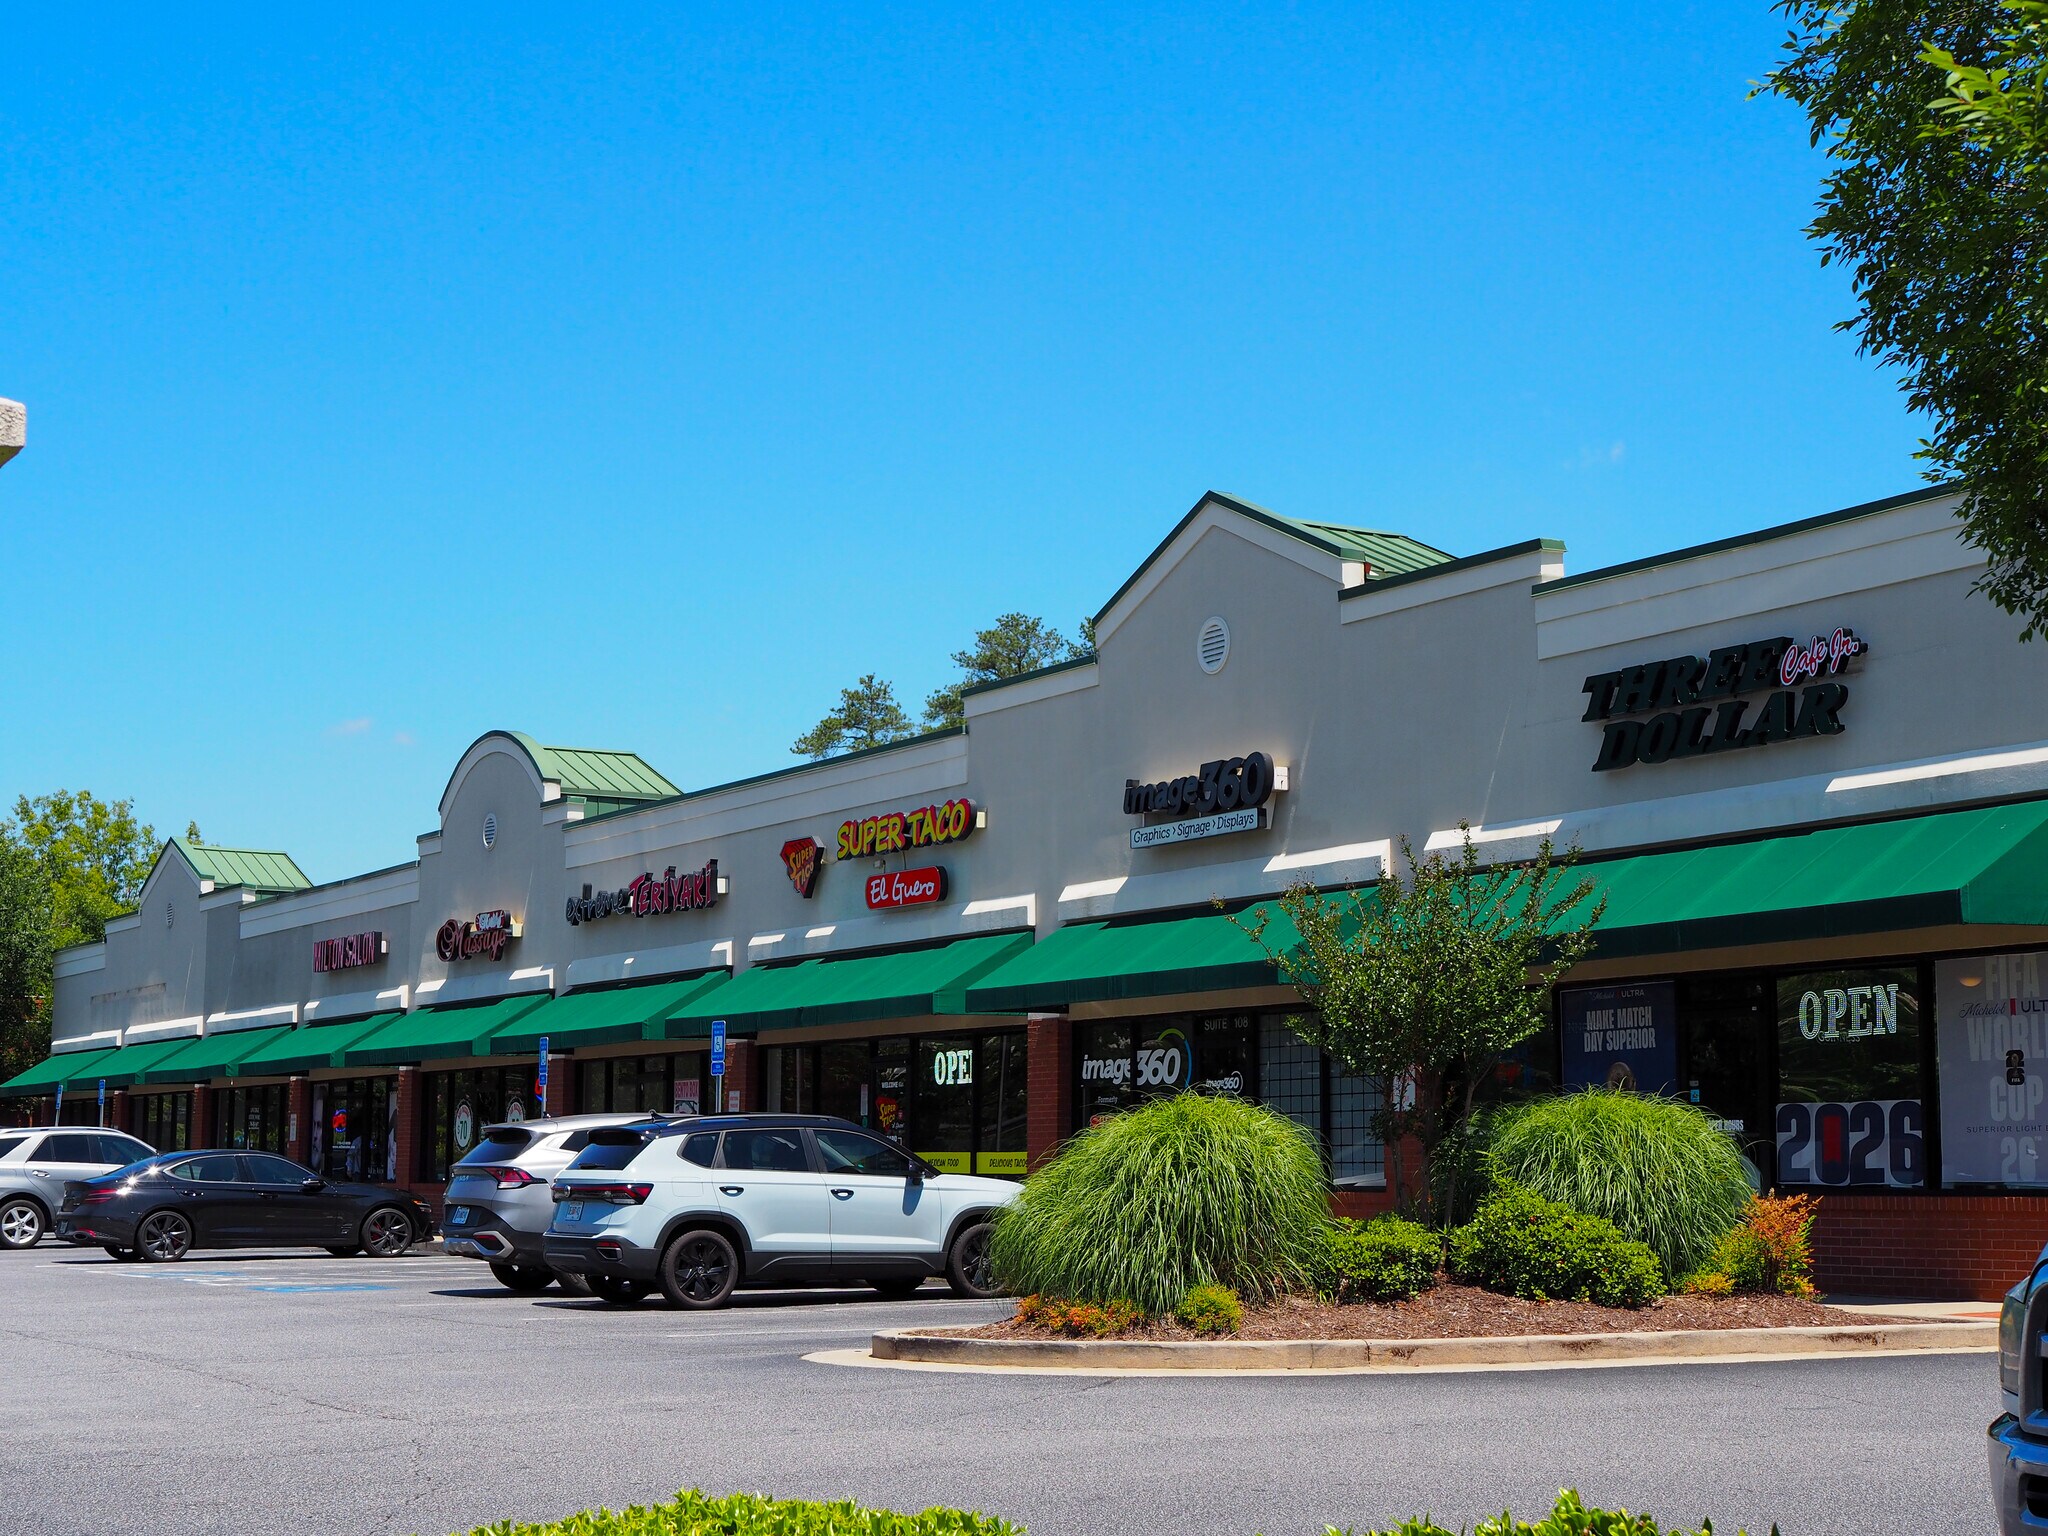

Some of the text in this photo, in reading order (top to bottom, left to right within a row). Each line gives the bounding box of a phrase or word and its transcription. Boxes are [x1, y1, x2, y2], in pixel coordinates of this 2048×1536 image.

[1780, 627, 1860, 686] Cafe Jr.
[1581, 637, 1793, 722] THREE
[1591, 683, 1847, 772] DOLLAR
[837, 799, 969, 860] SUPER TACO
[1133, 813, 1254, 844] Graphics Signage Displays
[789, 845, 814, 876] SUPER
[792, 862, 815, 888] TACO
[870, 873, 935, 905] El Guero
[345, 931, 376, 968] SALON
[436, 919, 507, 962] Massage
[1620, 988, 1645, 998] ULTRA
[1985, 954, 2040, 1001] FIFA
[1204, 1016, 1249, 1032] SUITE 108
[1586, 1008, 1615, 1031] MAKE
[1617, 1006, 1653, 1029] MATCH
[1799, 983, 1899, 1040] OPEN
[1959, 999, 2005, 1020] Michelob
[1583, 1030, 1604, 1053] DAY
[1606, 1027, 1657, 1051] SUPERIOR
[1990, 1075, 2043, 1122] CUP
[457, 1120, 468, 1140] $70
[1777, 1101, 1925, 1185] 2026
[1967, 1125, 2012, 1134] SUPERIOR
[2016, 1124, 2042, 1133] LIGHT
[947, 1158, 960, 1167] FOOD
[989, 1158, 1013, 1168] DELICIOUS
[2001, 1136, 2036, 1183] 26
